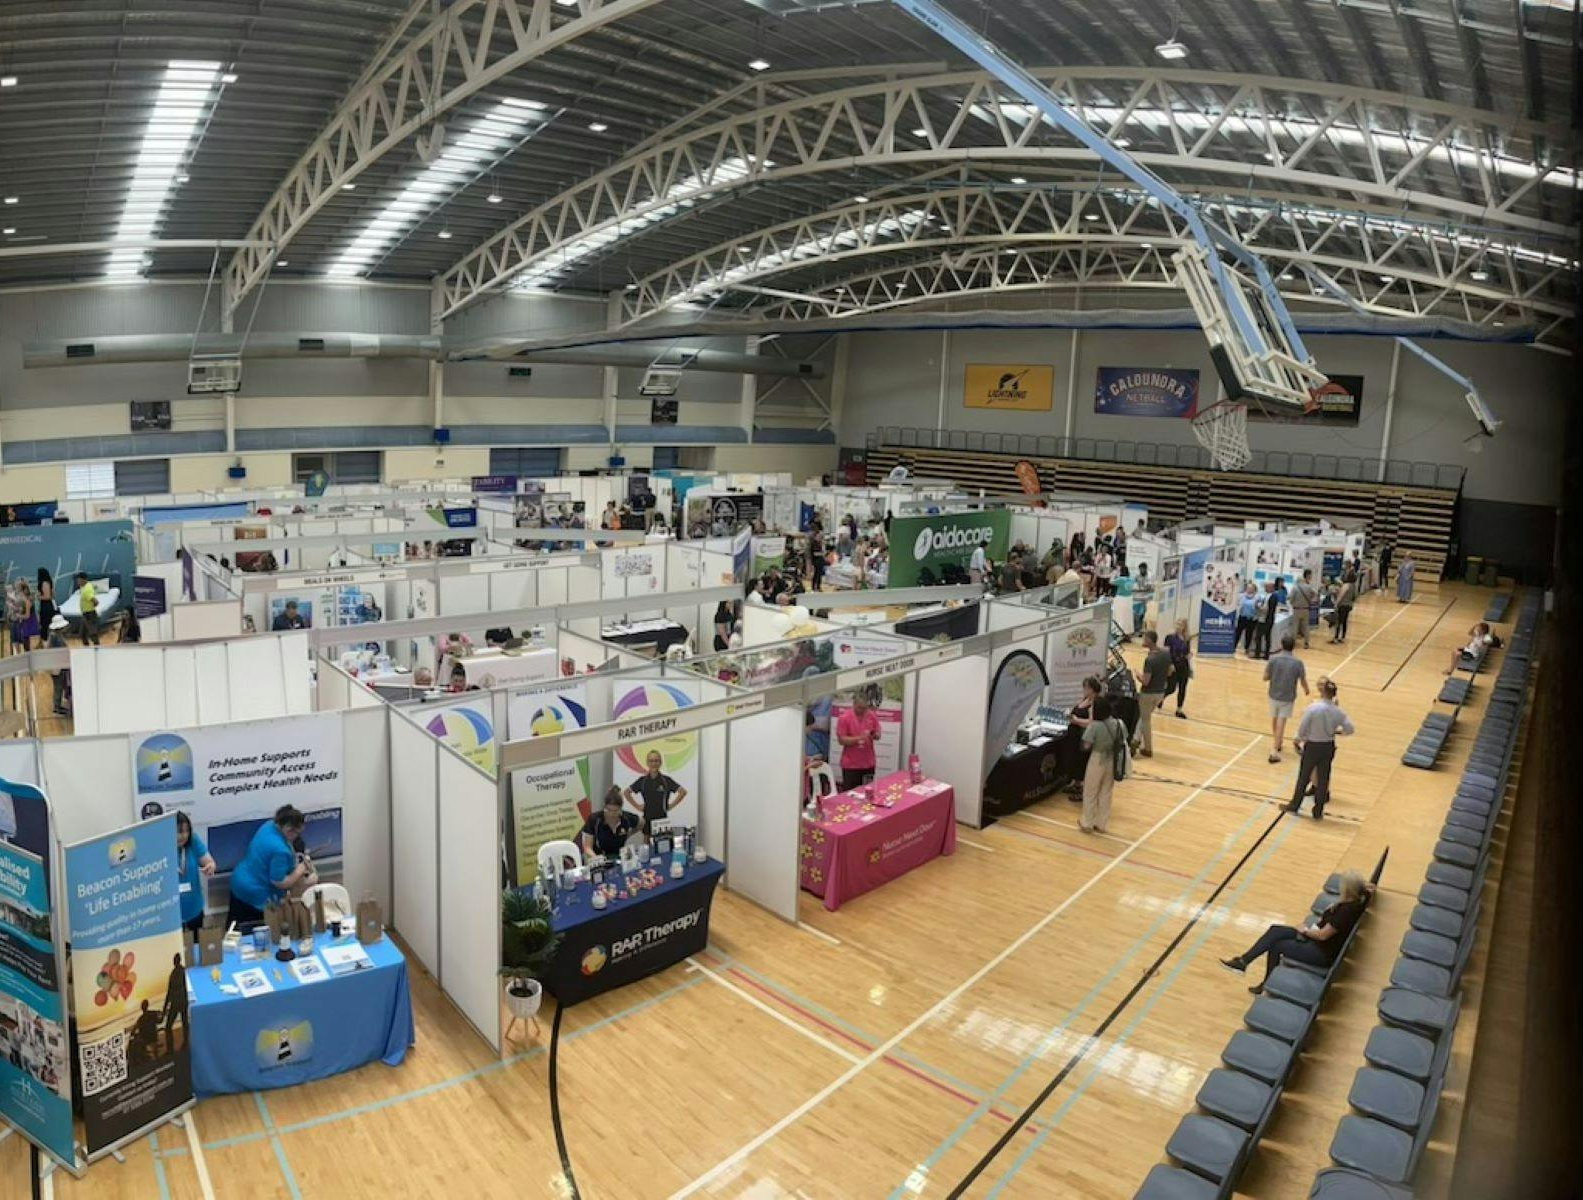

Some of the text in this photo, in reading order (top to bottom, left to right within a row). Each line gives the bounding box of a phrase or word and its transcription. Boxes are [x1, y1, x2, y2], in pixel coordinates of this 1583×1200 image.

[1110, 373, 1186, 399] CALOUNDRA
[933, 525, 994, 550] aidacare
[618, 718, 677, 740] RAR THERAPY
[208, 748, 312, 770] In-Home Supports
[209, 761, 316, 783] Community Access
[209, 770, 339, 797] Complex Health Needs
[526, 768, 575, 784] Occupational
[536, 781, 565, 792] Therapy
[77, 857, 168, 899] Beacon Support
[611, 932, 643, 957] RAR
[644, 907, 704, 942] Therapy
